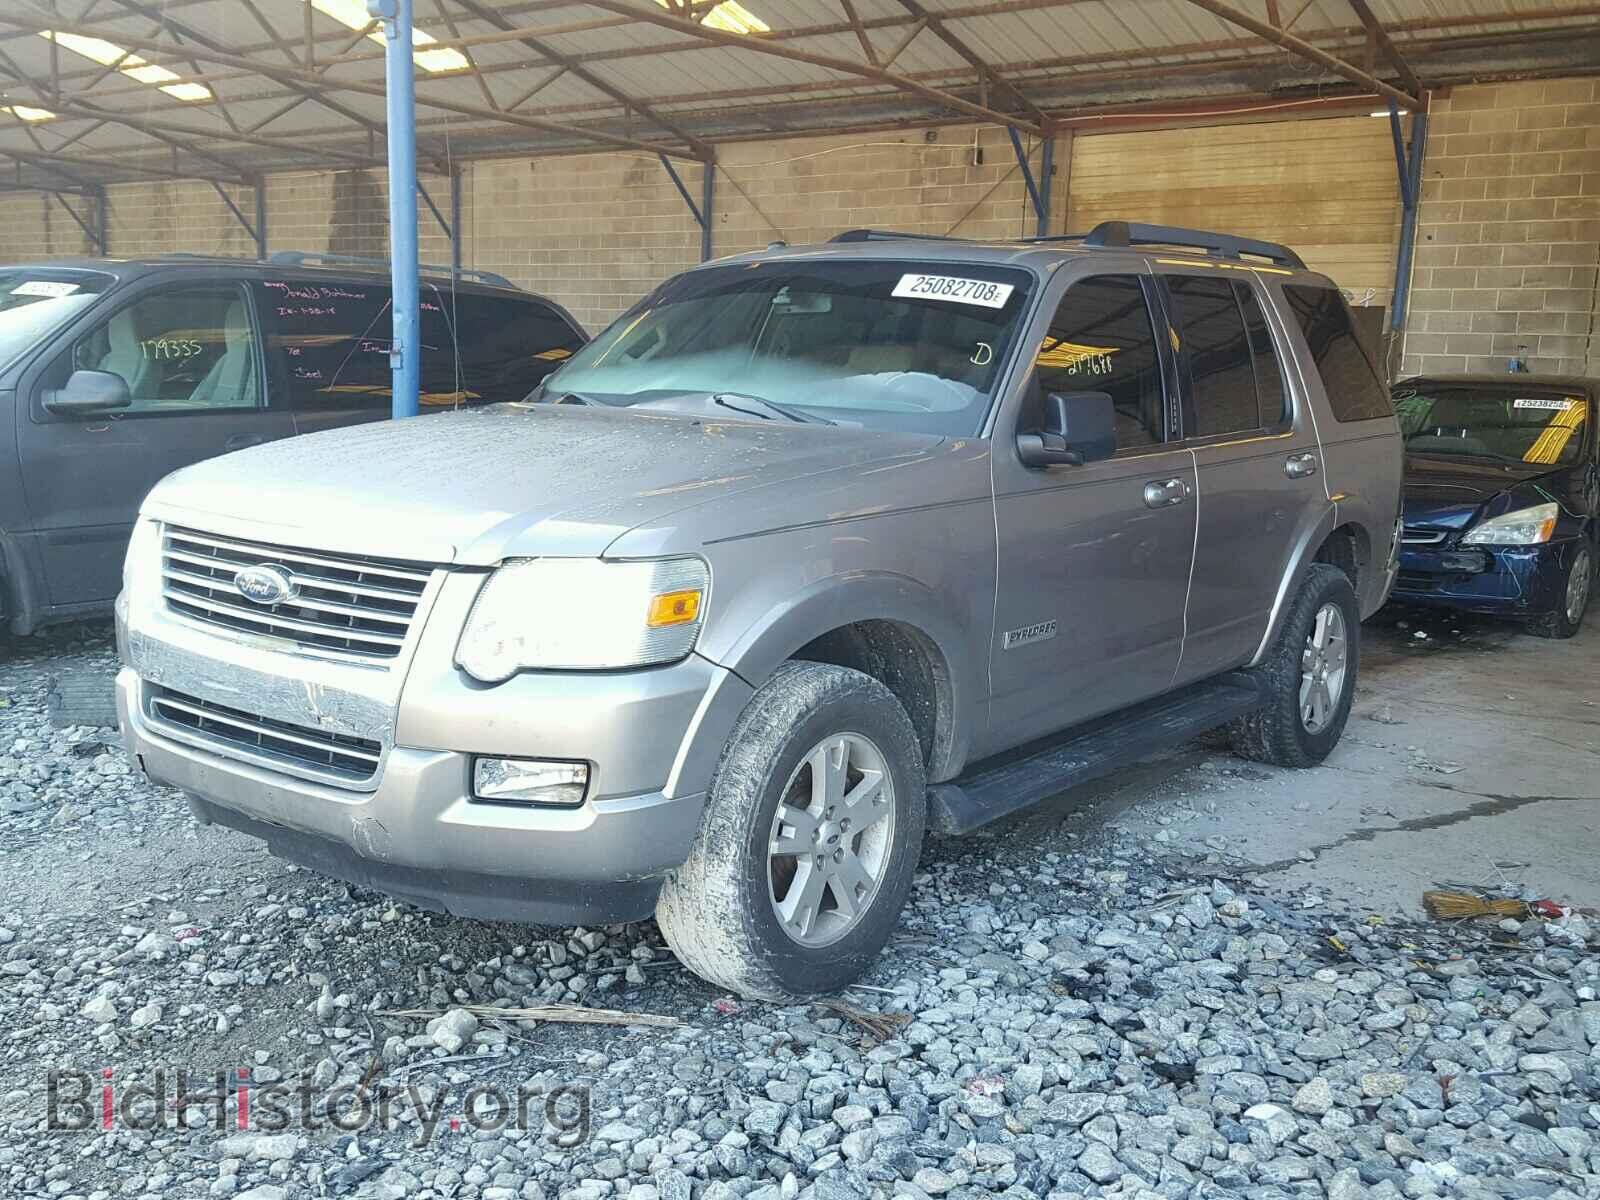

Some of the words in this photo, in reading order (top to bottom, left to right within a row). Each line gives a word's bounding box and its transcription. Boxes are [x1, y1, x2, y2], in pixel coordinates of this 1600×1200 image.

[910, 277, 997, 301] 25082708
[140, 338, 202, 359] 179335
[970, 342, 992, 365] D
[239, 577, 273, 596] Ford
[1008, 621, 1057, 641] EXPLORER
